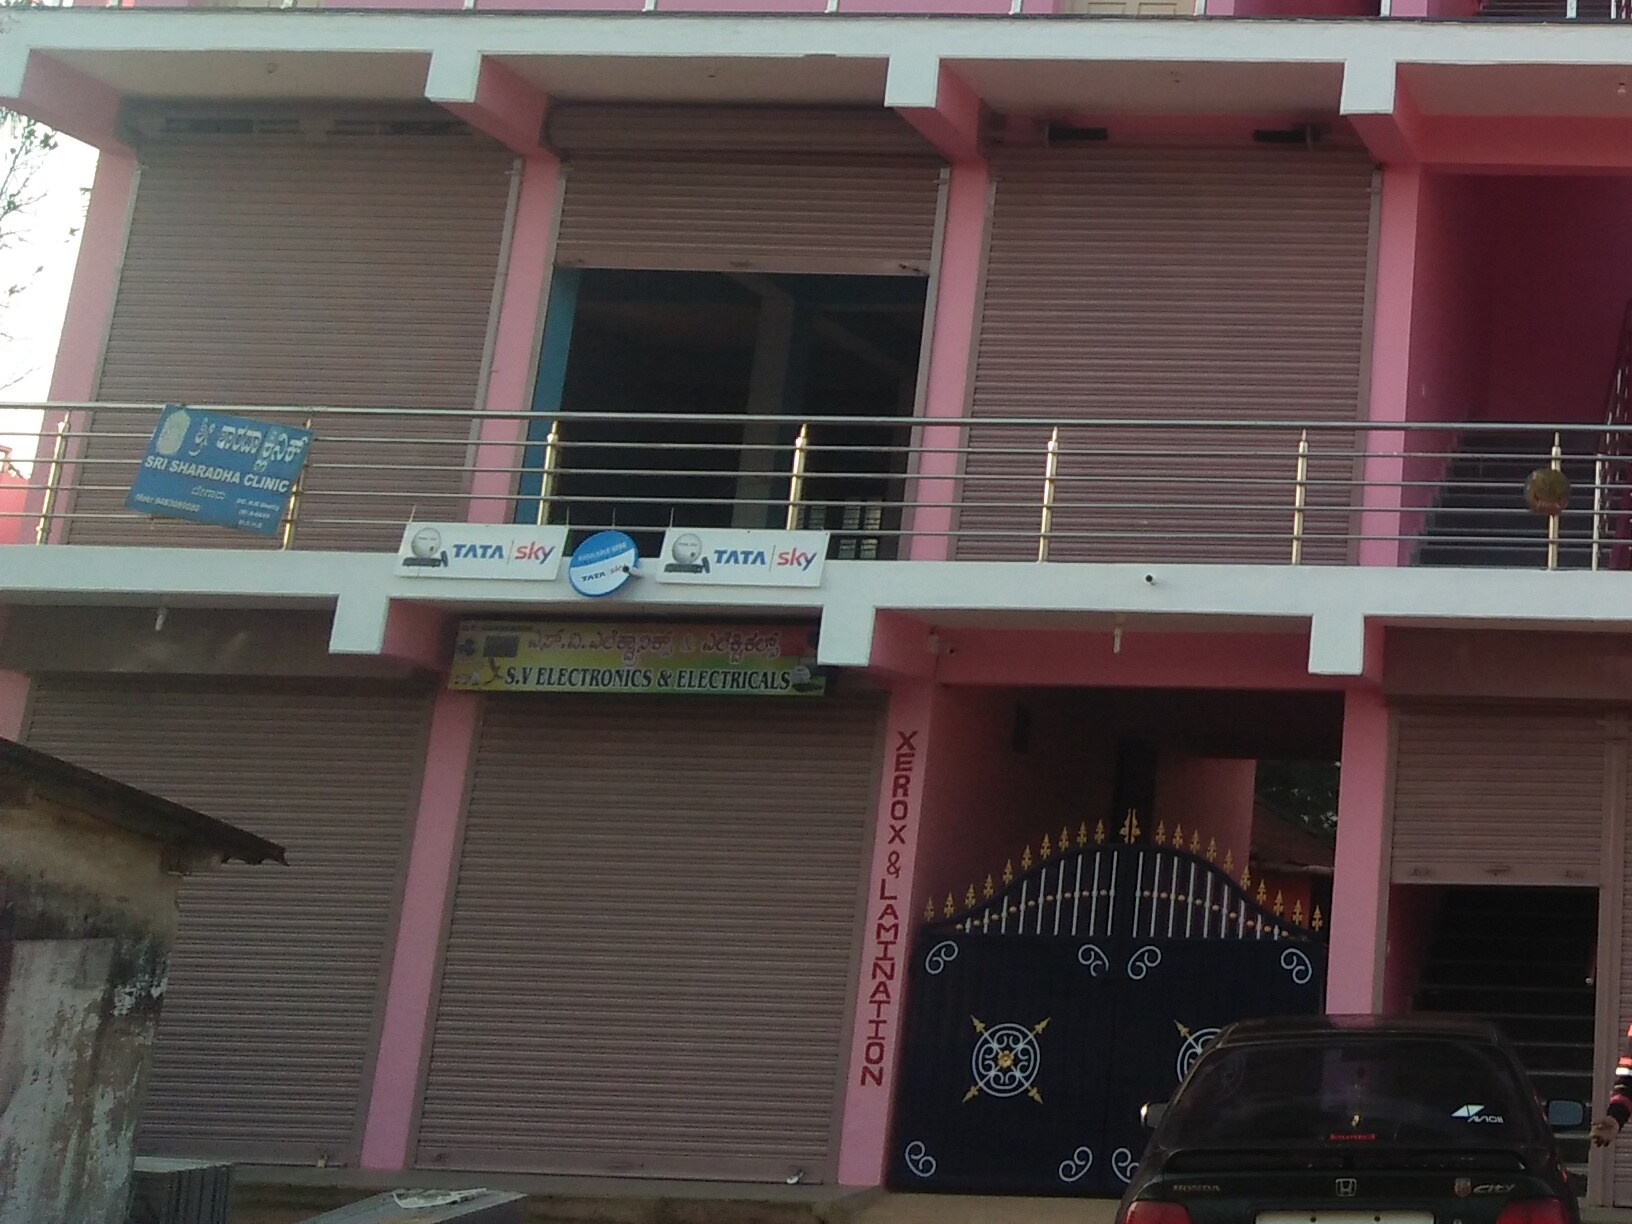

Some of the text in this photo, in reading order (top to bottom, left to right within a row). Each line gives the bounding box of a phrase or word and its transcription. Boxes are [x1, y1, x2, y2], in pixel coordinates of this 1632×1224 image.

[144, 455, 290, 493] SRI SHARADHA CLINIC
[453, 541, 555, 565] TATA sky
[714, 547, 817, 571] TATA sky
[581, 571, 606, 582] TATA
[504, 665, 791, 690] S.V ELECTRONICS & ELECTRICALS
[860, 730, 918, 1087] XEROX & LAMINATION
[1172, 1183, 1221, 1193] HONDA
